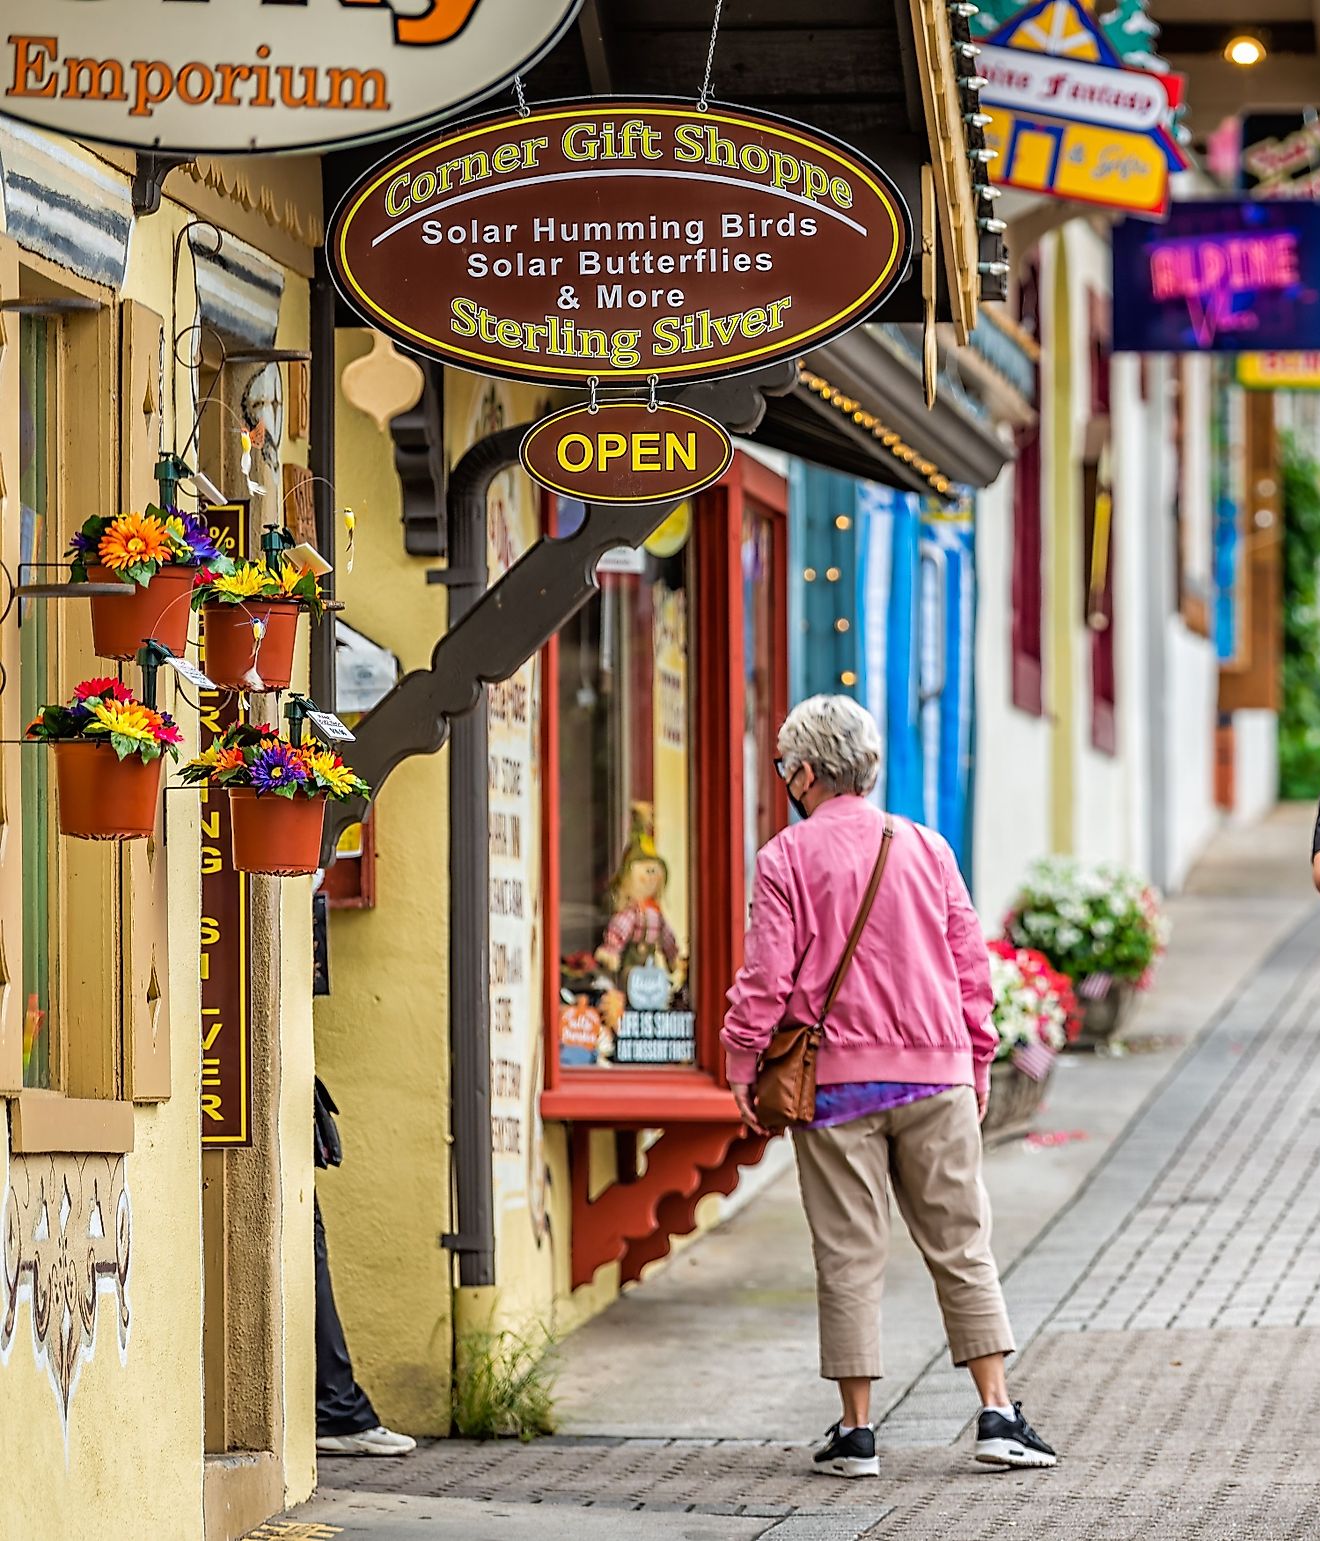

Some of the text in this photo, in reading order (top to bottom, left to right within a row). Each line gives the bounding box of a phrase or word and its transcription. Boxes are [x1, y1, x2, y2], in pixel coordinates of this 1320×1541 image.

[5, 34, 392, 118] Emporium
[383, 118, 855, 219] Corner Gift Shoppe
[420, 212, 819, 247] Solar Humming Birds
[466, 248, 774, 280] Solar Butterflies
[555, 283, 686, 310] & More
[450, 294, 793, 369] Sterling Silver
[556, 432, 698, 474] OPEN
[617, 1011, 695, 1039] LIFE IS SHORT
